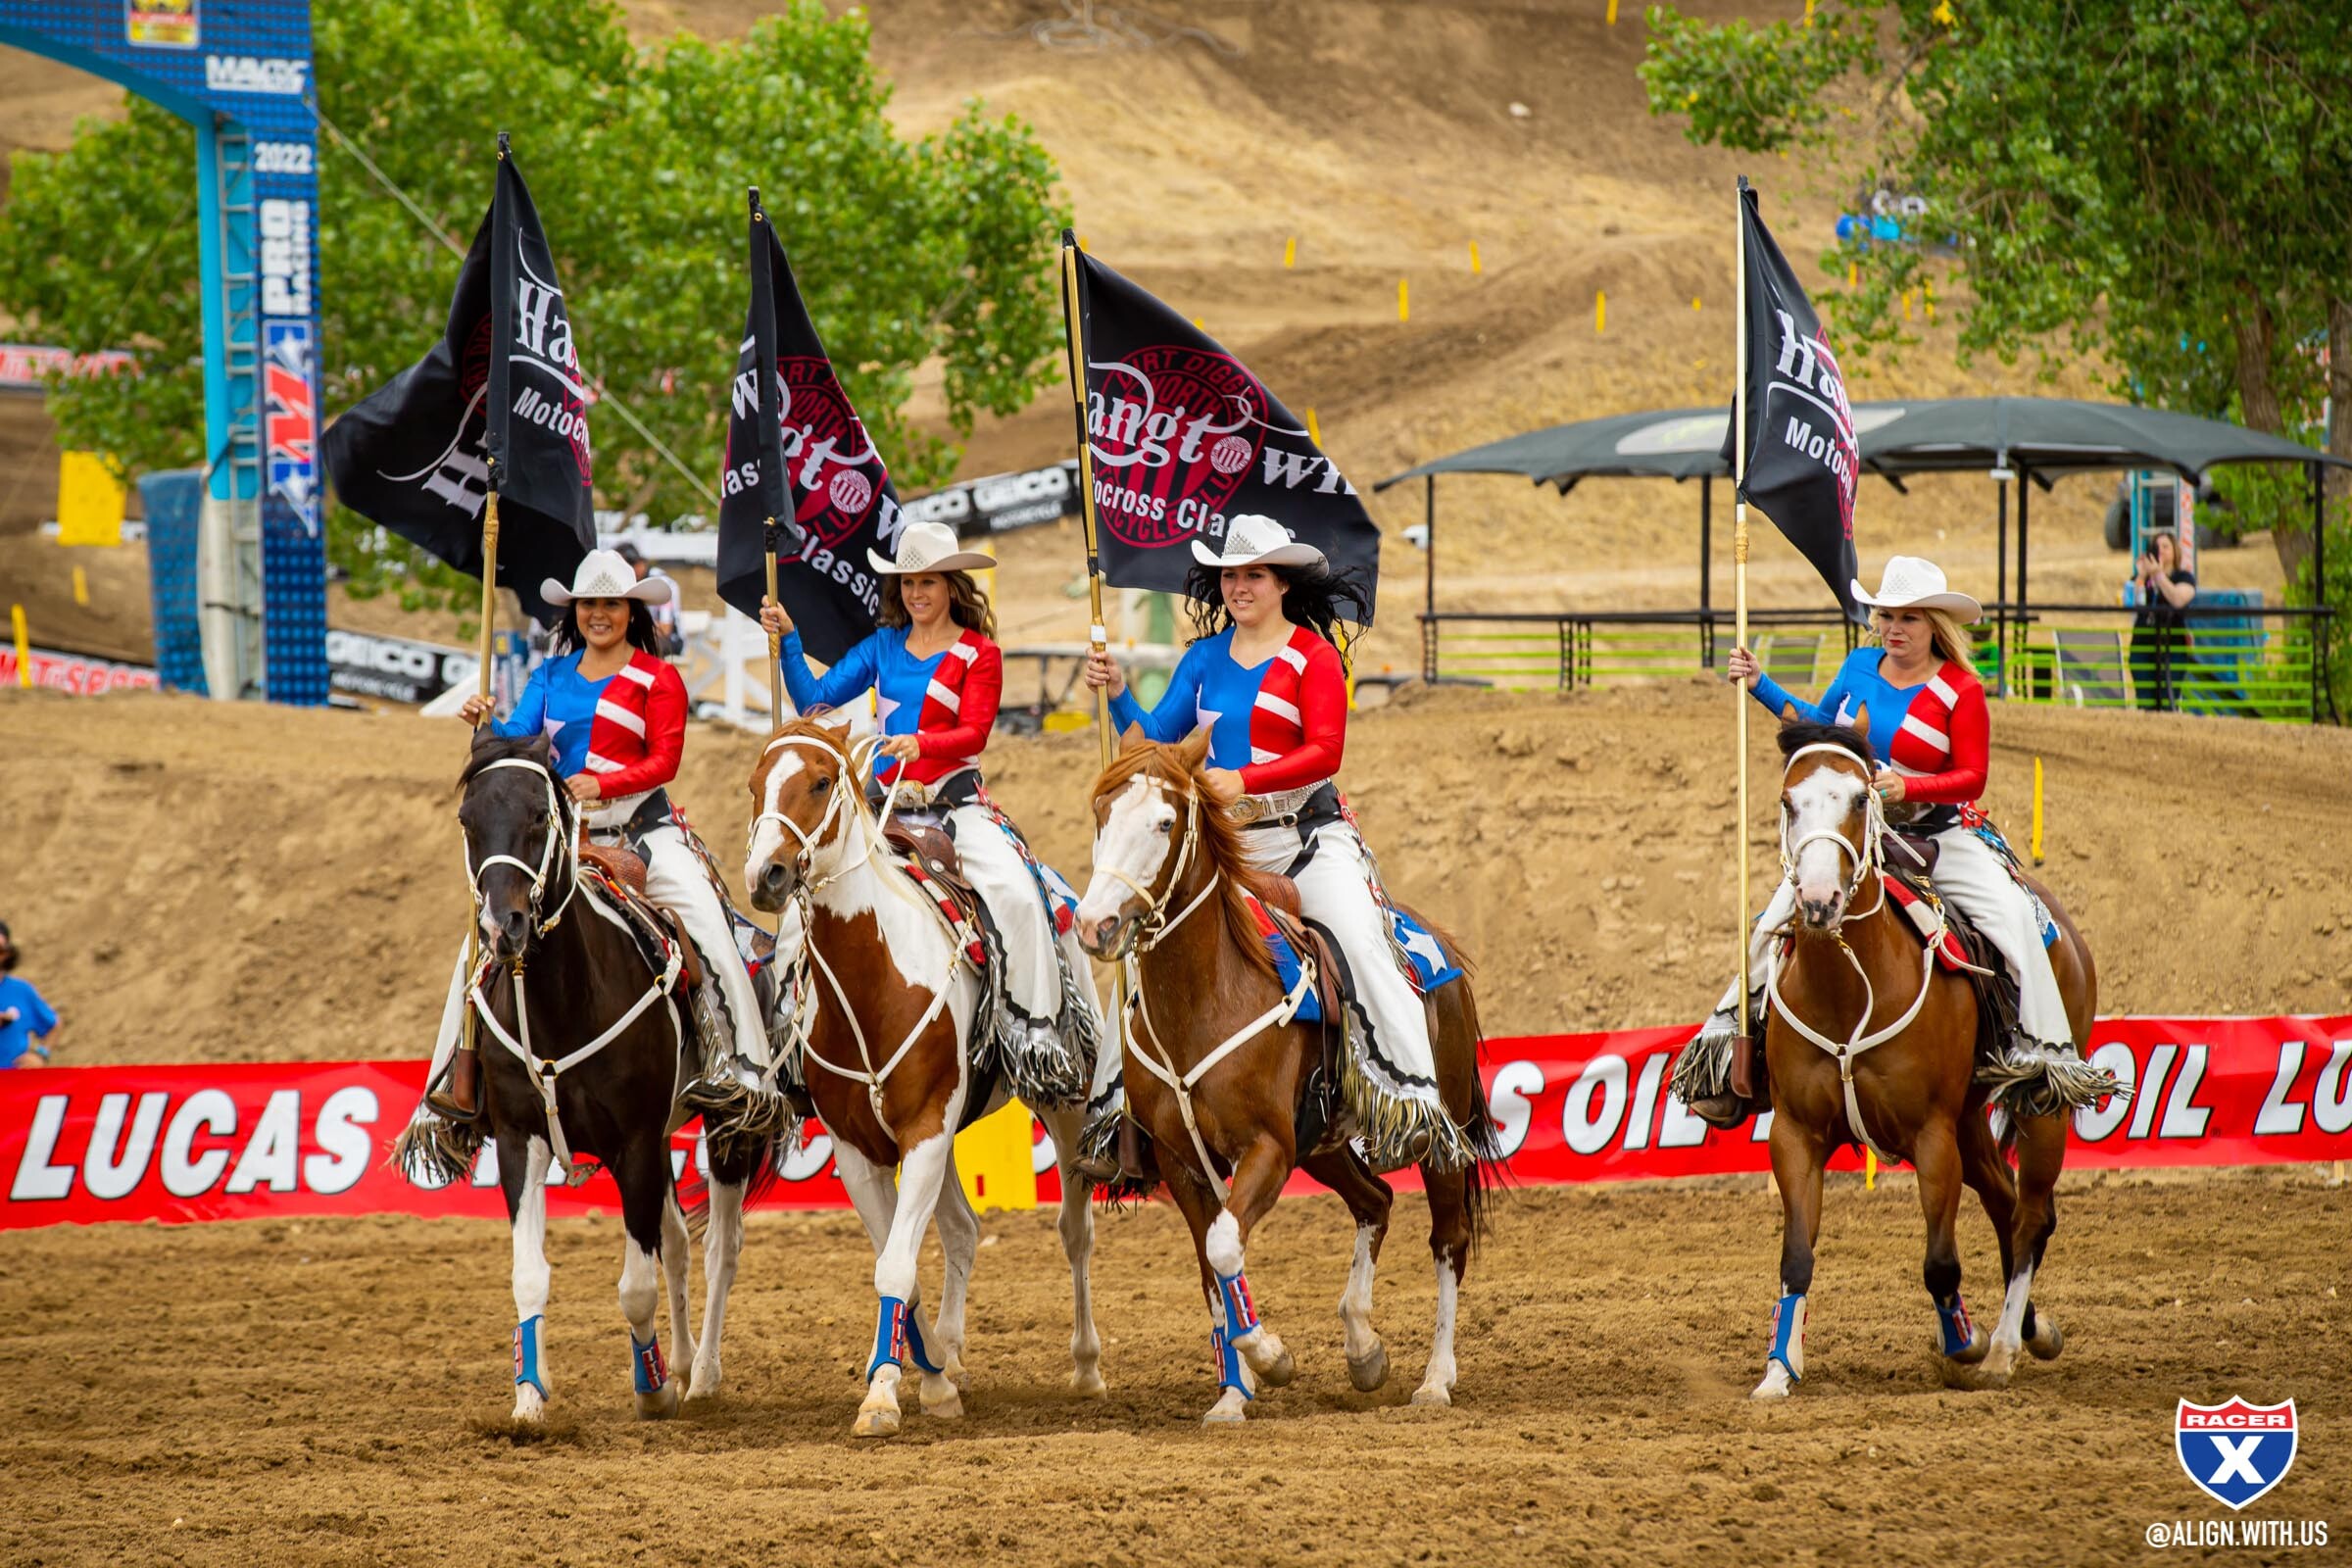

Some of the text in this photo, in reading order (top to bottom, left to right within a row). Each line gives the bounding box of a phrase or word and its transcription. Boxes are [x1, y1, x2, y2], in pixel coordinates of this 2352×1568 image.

[254, 142, 313, 173] 2022
[260, 199, 292, 315] PRO
[973, 466, 1070, 513] GEICO
[325, 630, 435, 680] GEICO
[1562, 1053, 1708, 1155] OIL
[2074, 1041, 2215, 1142] OIL
[10, 1086, 379, 1200] LUCAS
